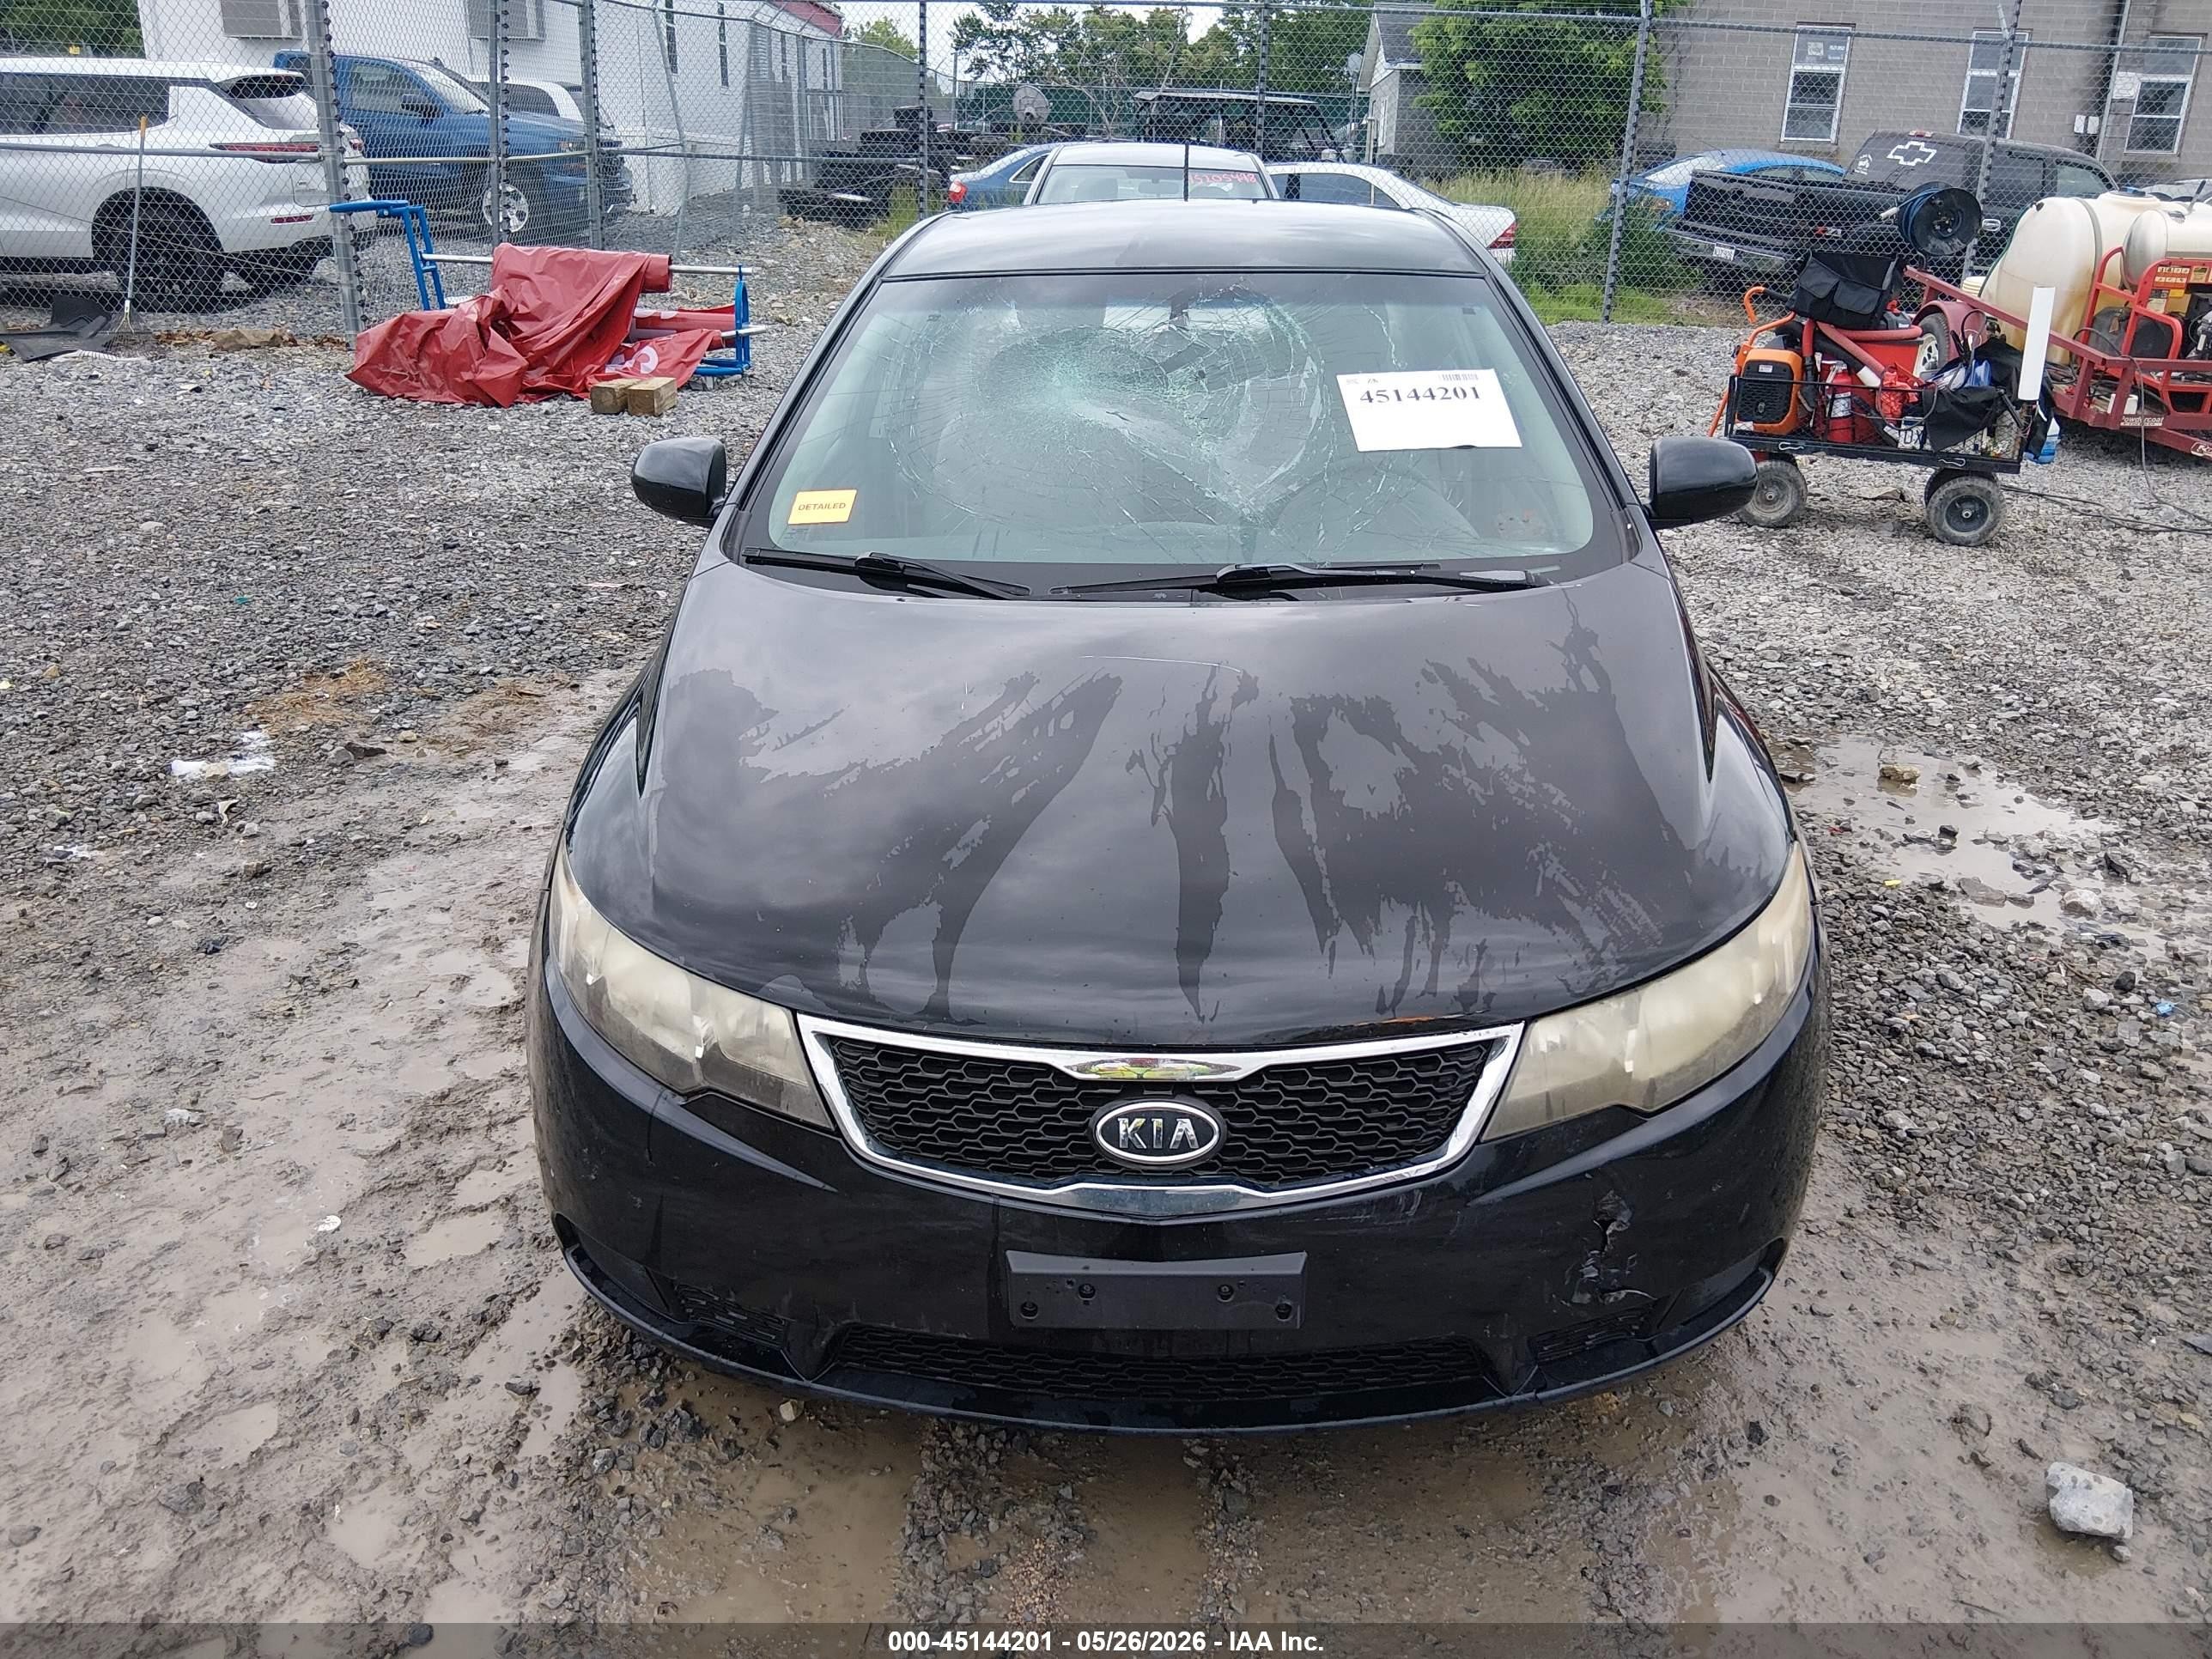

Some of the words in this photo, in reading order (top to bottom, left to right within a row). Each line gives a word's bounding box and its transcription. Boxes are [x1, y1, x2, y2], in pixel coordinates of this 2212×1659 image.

[1359, 386, 1480, 404] 45144201
[798, 502, 847, 511] DETAILED
[1117, 1117, 1200, 1150] KIA
